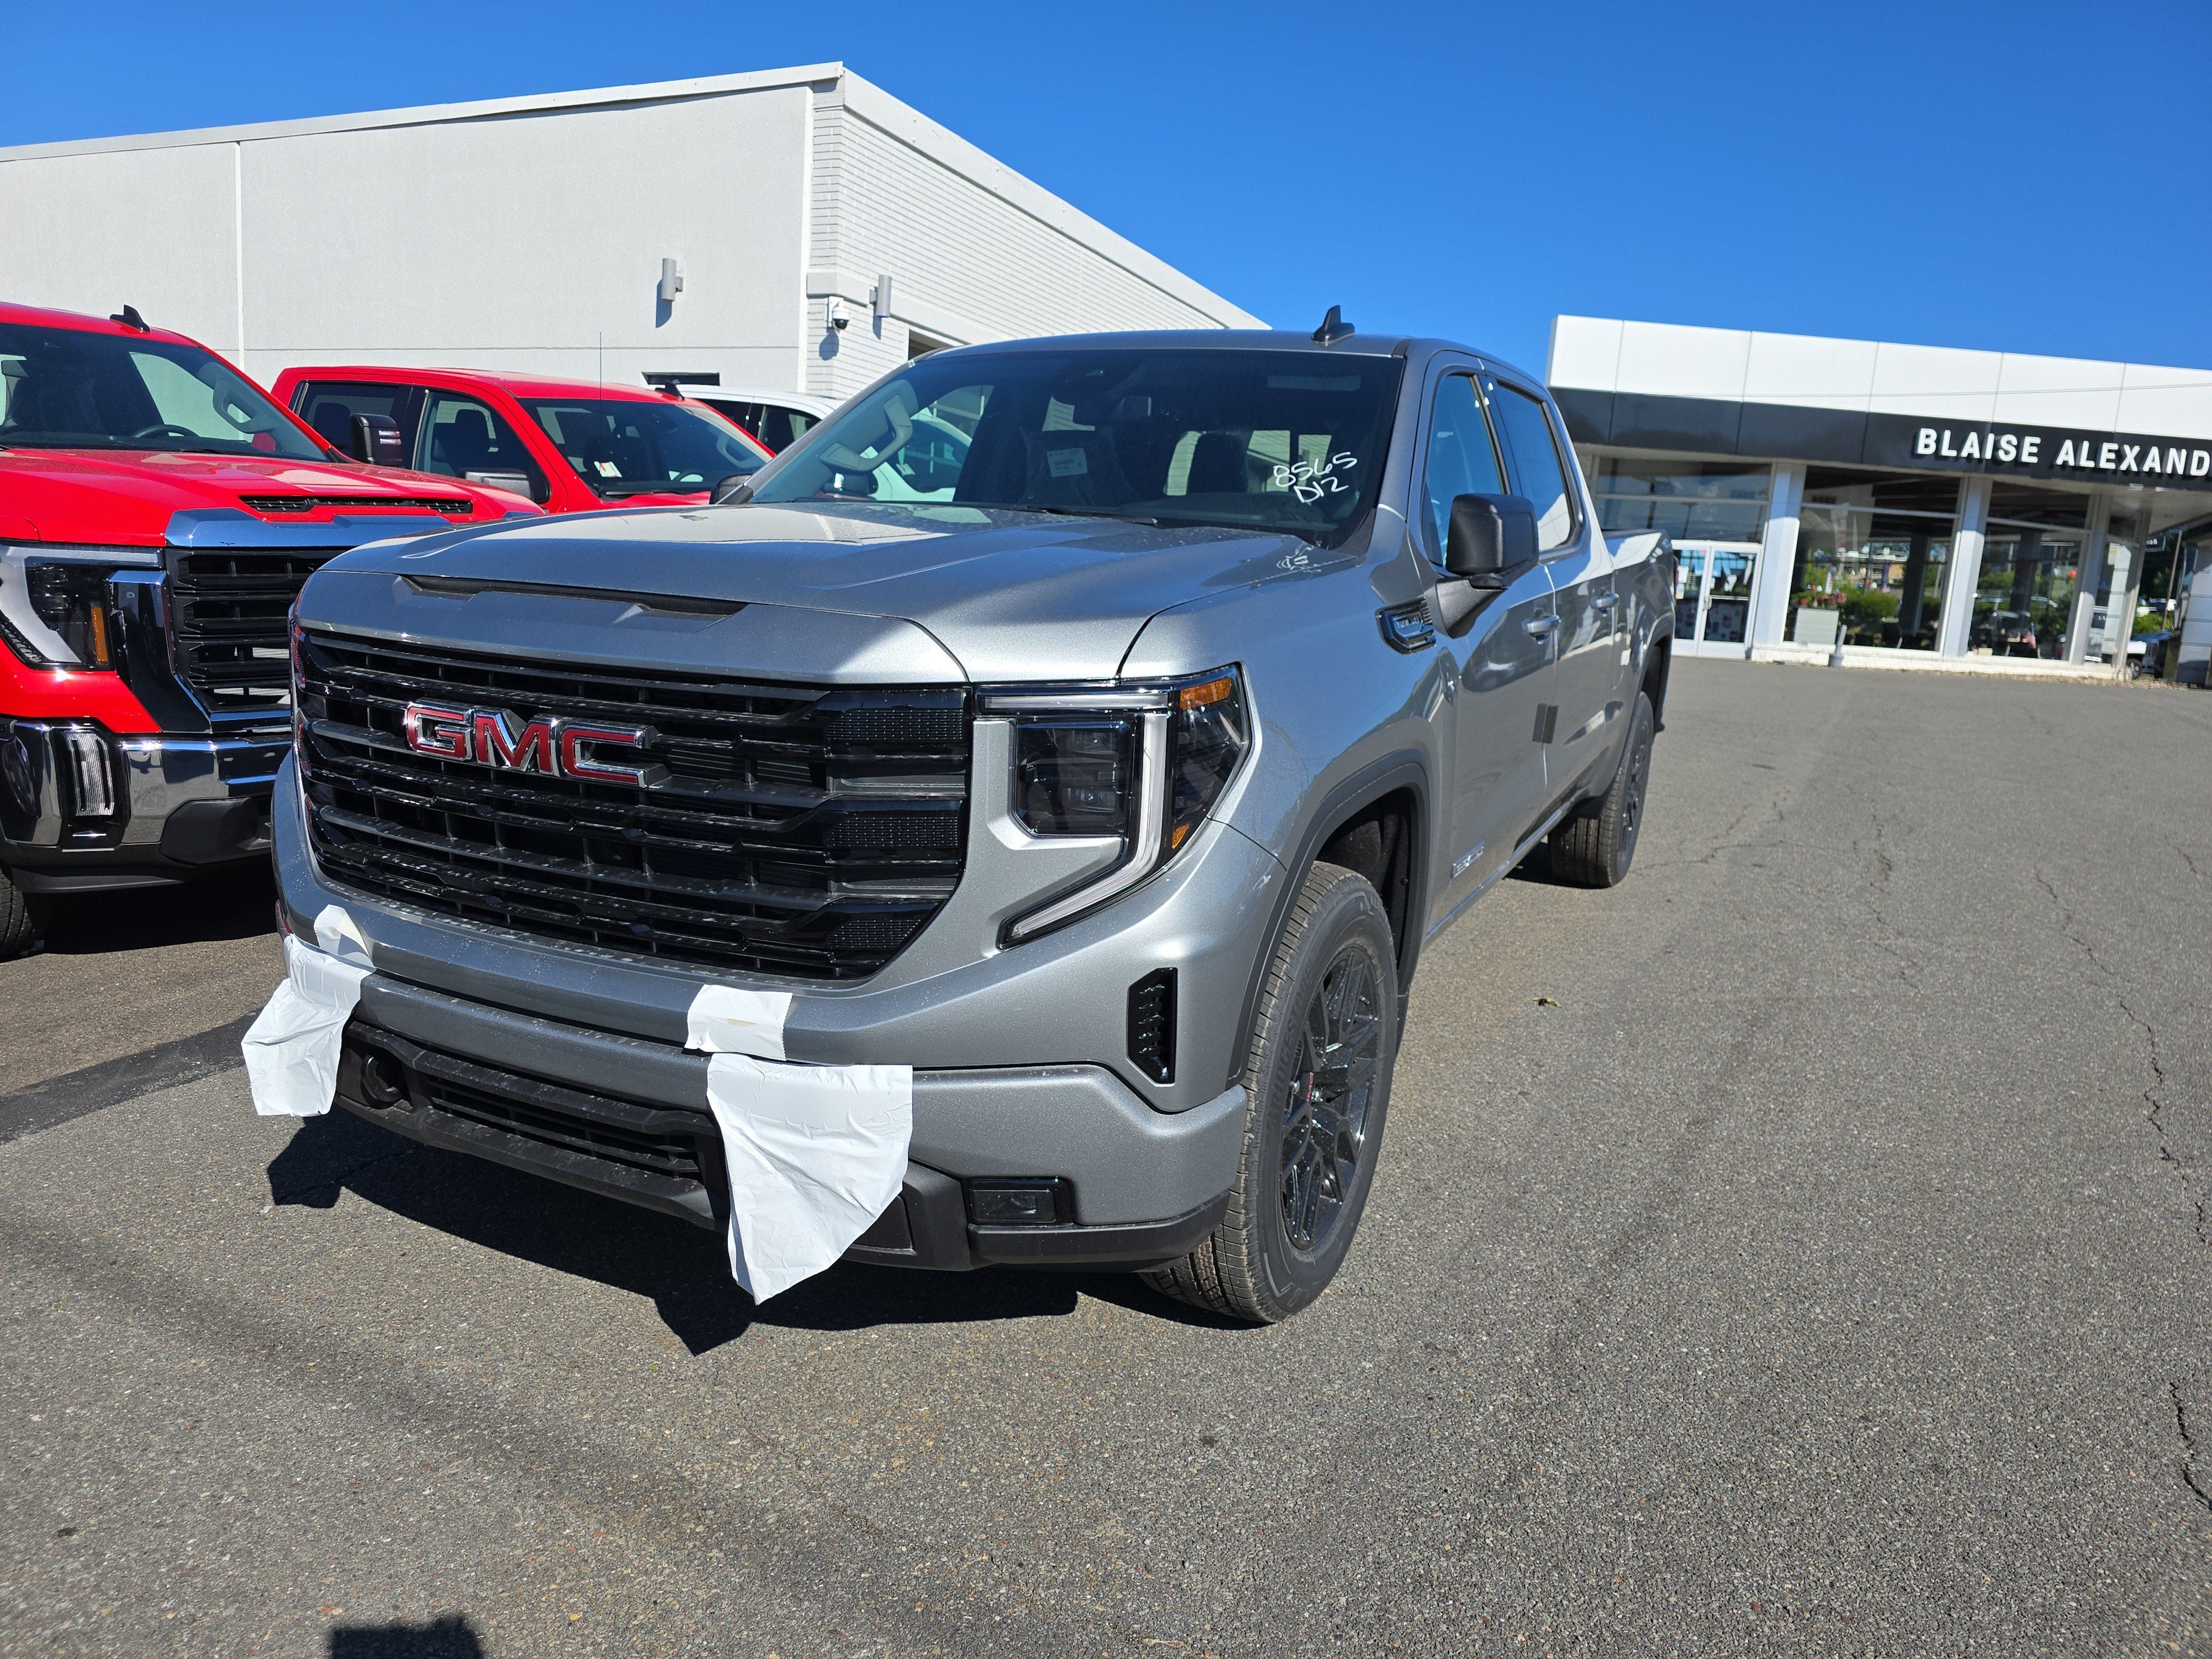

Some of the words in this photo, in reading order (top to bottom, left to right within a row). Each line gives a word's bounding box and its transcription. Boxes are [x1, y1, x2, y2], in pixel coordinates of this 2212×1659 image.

[1272, 451, 1358, 487] 8565
[1915, 427, 2042, 464] BLAISE
[2055, 439, 2211, 477] ALEXAND
[403, 699, 648, 789] GMC
